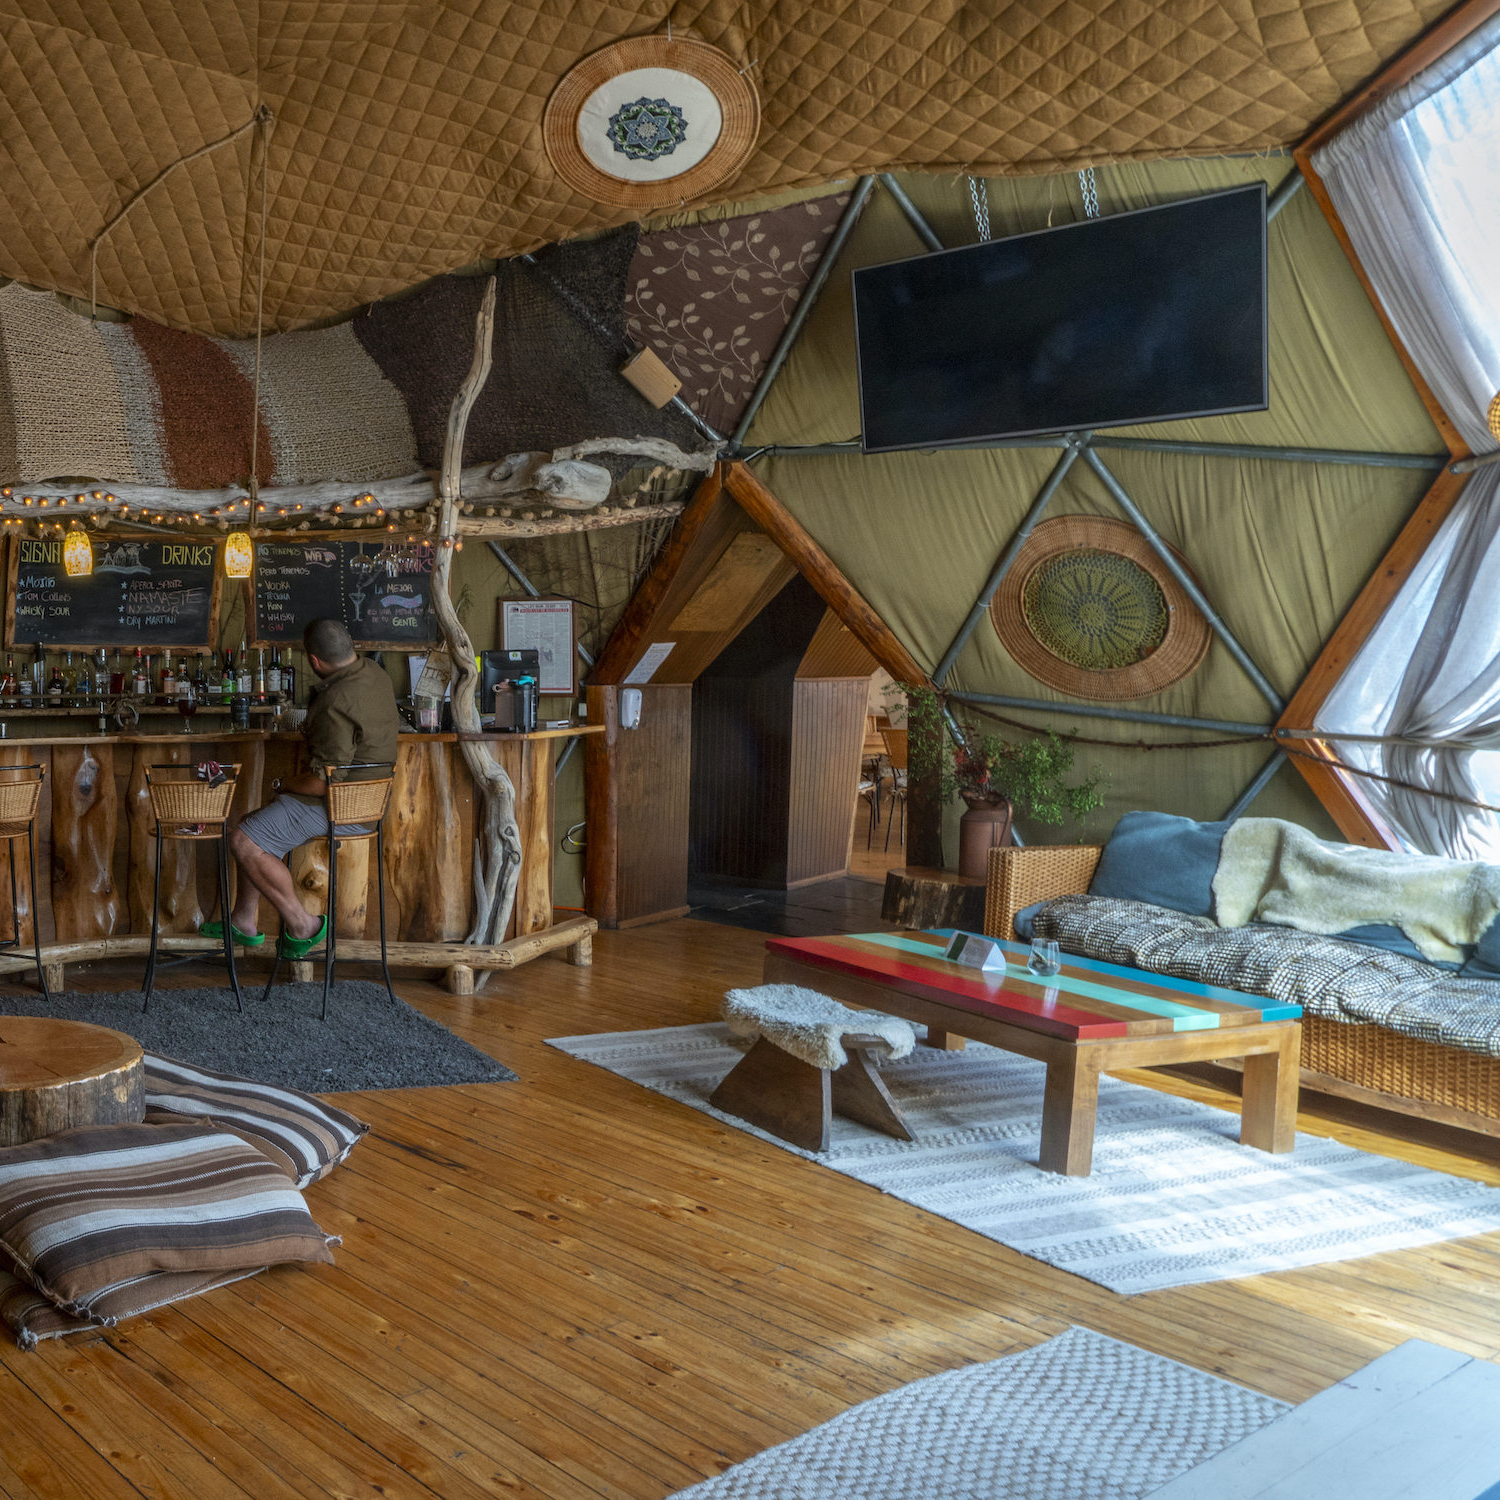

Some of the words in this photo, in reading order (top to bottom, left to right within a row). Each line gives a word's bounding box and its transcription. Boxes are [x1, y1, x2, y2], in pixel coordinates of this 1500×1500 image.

[21, 541, 61, 564] SIGNA
[162, 545, 213, 566] DRINKS
[257, 546, 269, 556] NO
[271, 547, 302, 556] TENEMOS
[259, 567, 277, 576] PERO
[278, 565, 311, 575] TENEMOS
[264, 580, 291, 590] VODKA
[386, 583, 413, 593] MEJOR
[128, 587, 204, 606] NAMASTE
[265, 591, 291, 600] TEQUILA
[49, 605, 71, 616] SOUR
[128, 605, 143, 614] NY
[145, 604, 180, 615] SOUR
[267, 601, 283, 610] RON
[267, 612, 295, 624] WHISKY
[392, 616, 418, 627] GENTE
[425, 666, 449, 682] TIPS
